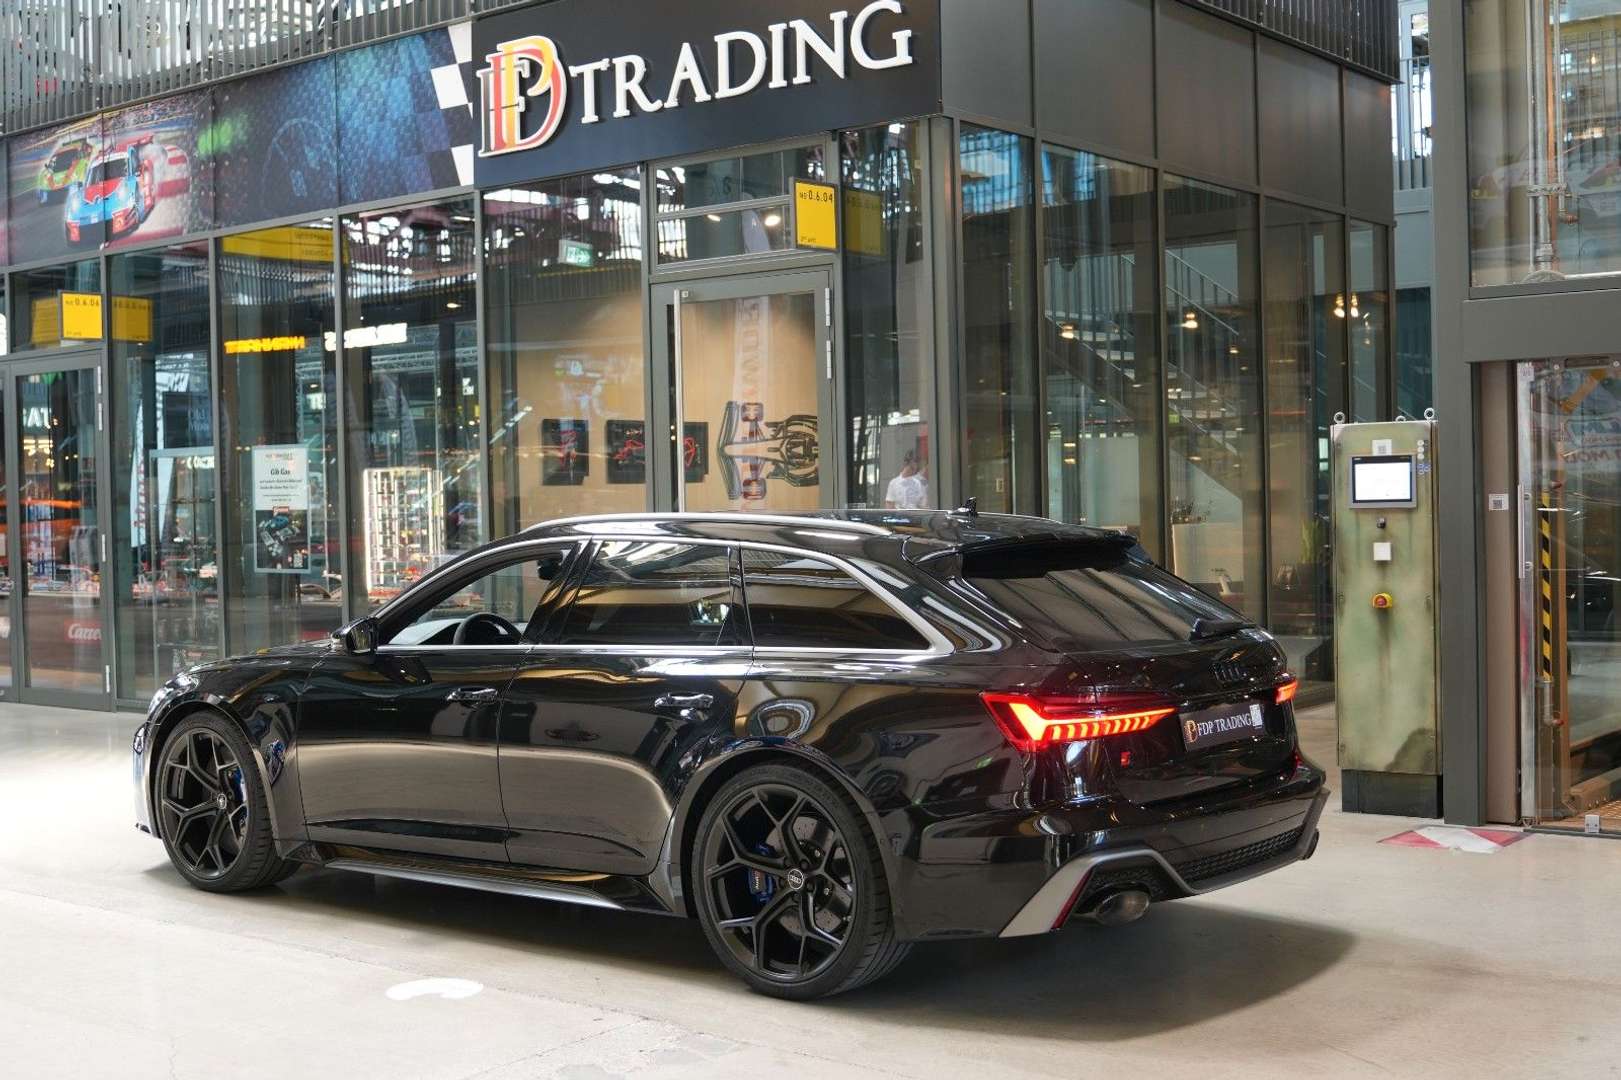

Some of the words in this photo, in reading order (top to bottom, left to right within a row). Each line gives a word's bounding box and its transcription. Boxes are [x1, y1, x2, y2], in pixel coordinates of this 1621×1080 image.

[569, 0, 914, 124] TRADING
[1197, 720, 1214, 736] FDP
[1214, 712, 1251, 732] TRADING
